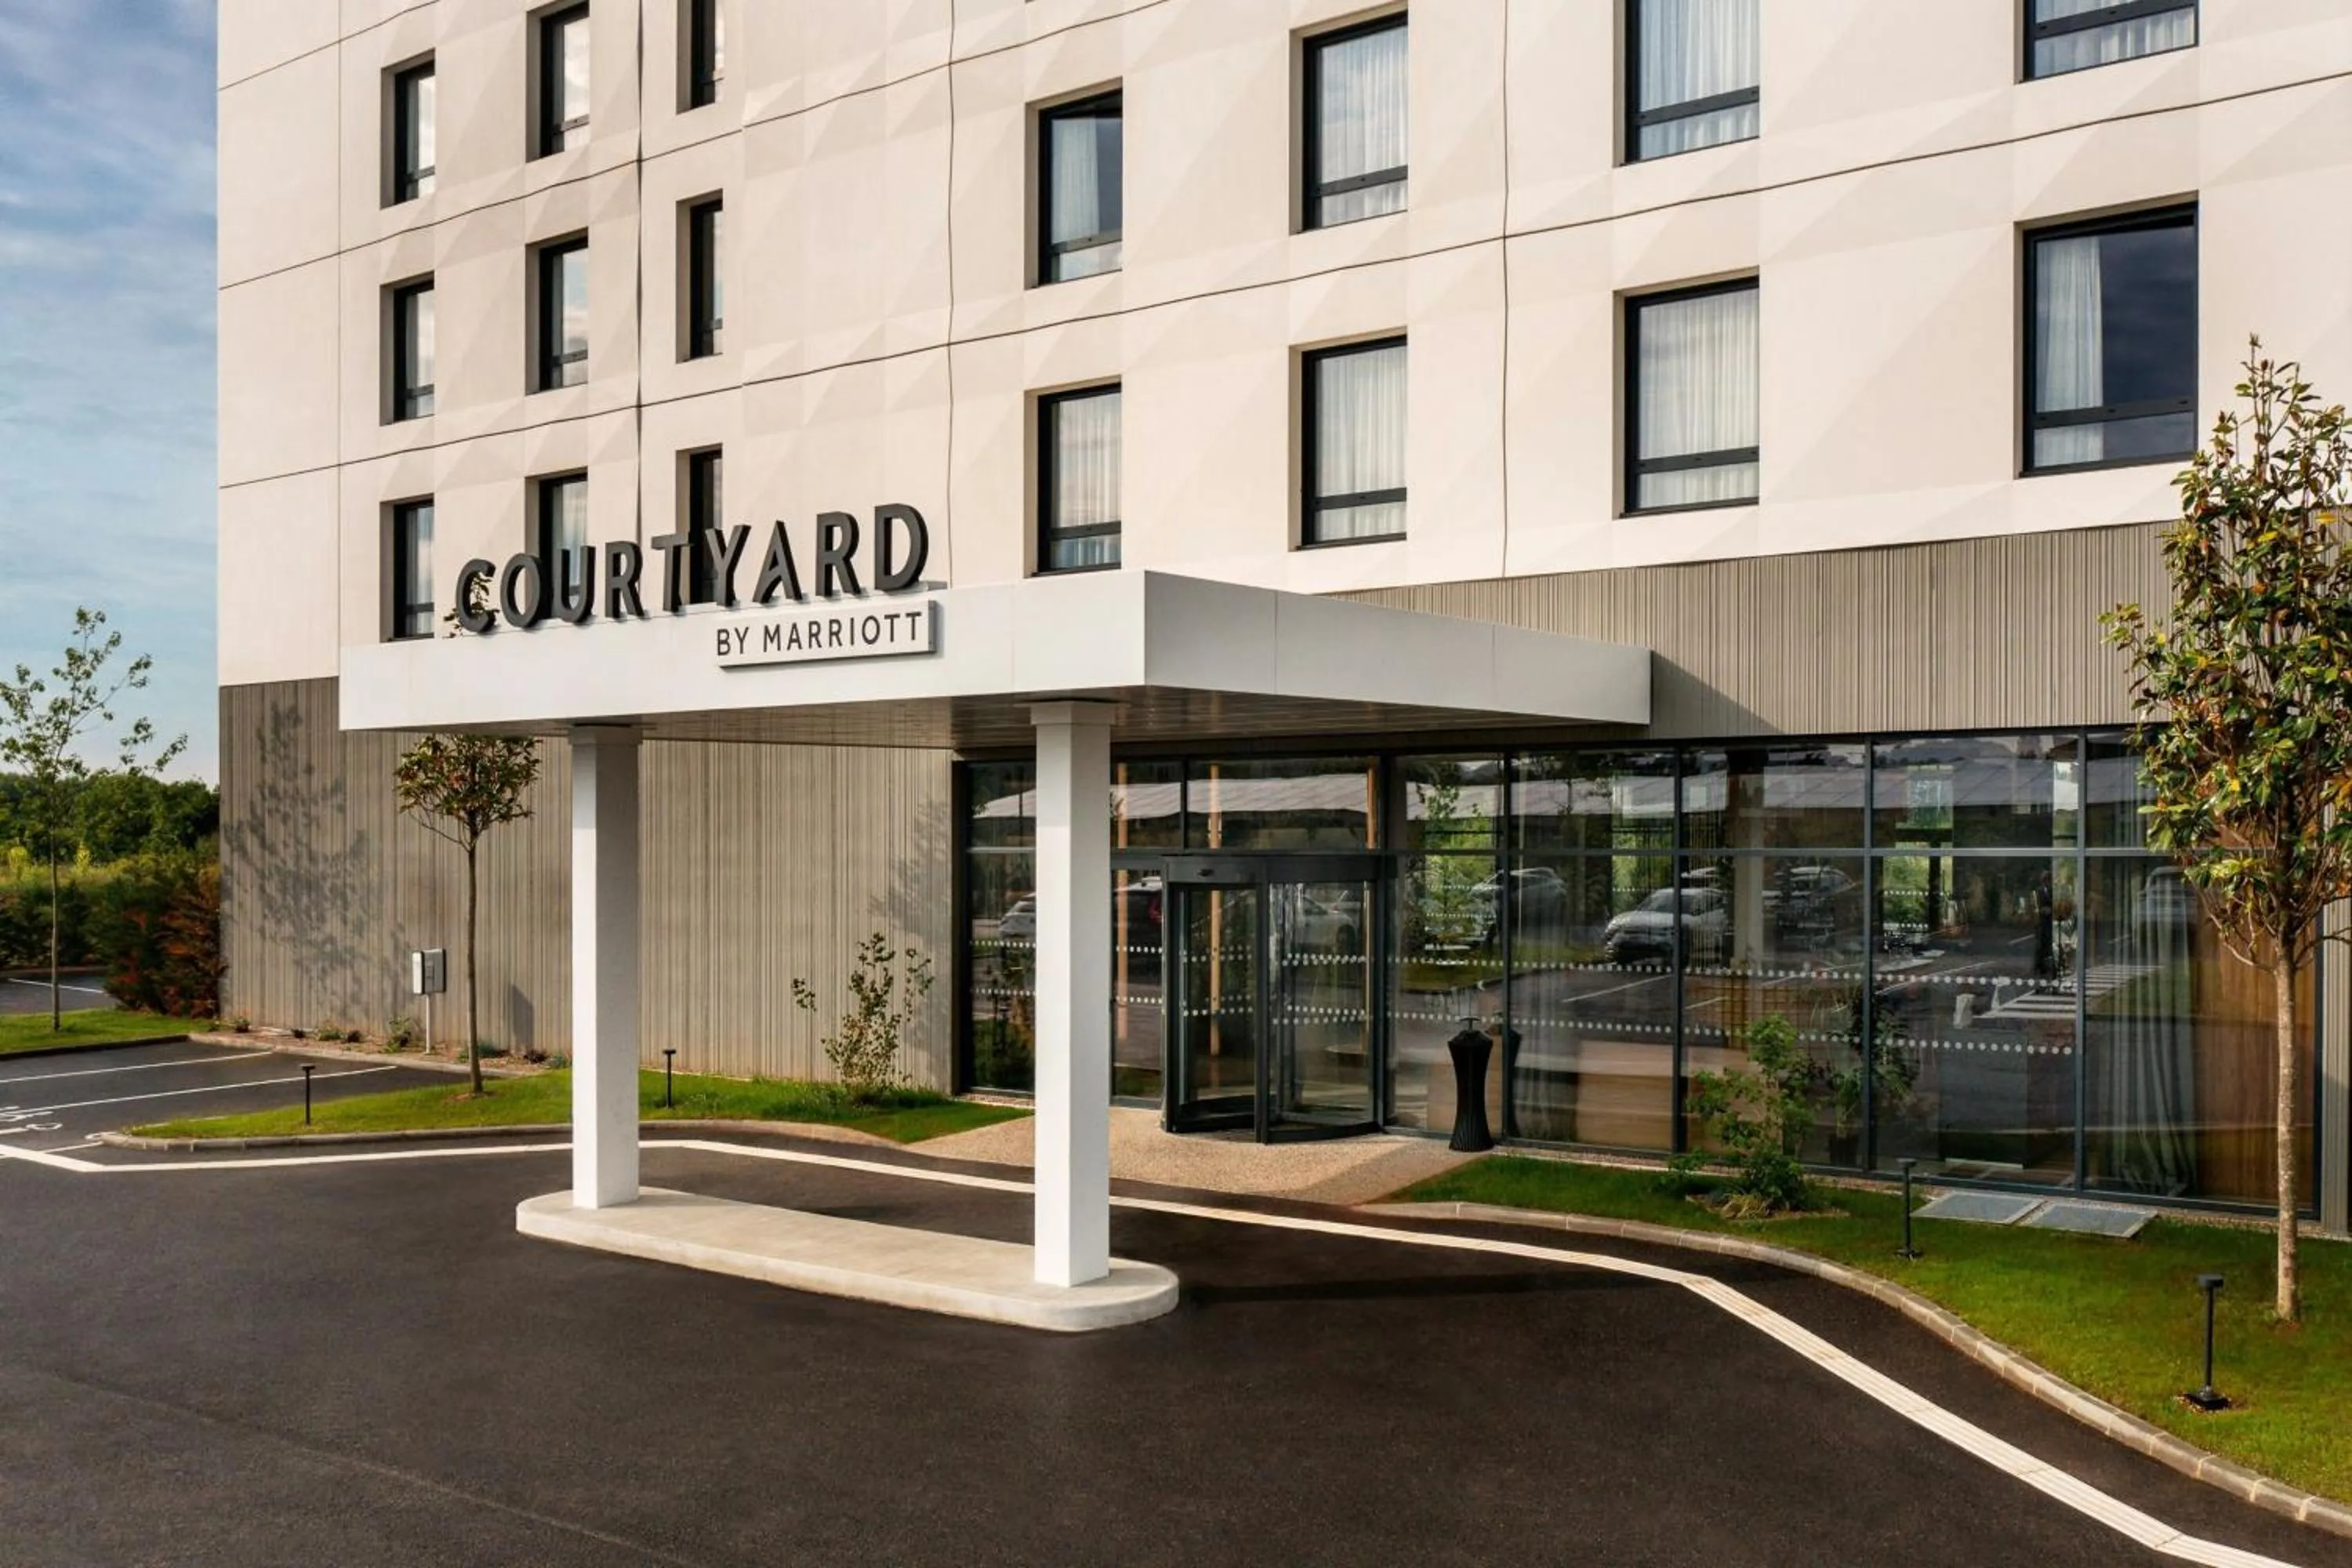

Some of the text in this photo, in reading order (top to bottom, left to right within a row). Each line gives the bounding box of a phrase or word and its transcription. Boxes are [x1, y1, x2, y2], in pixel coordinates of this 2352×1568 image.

[456, 503, 929, 633] COURTYARD
[717, 611, 923, 656] BY MARRIOTT
